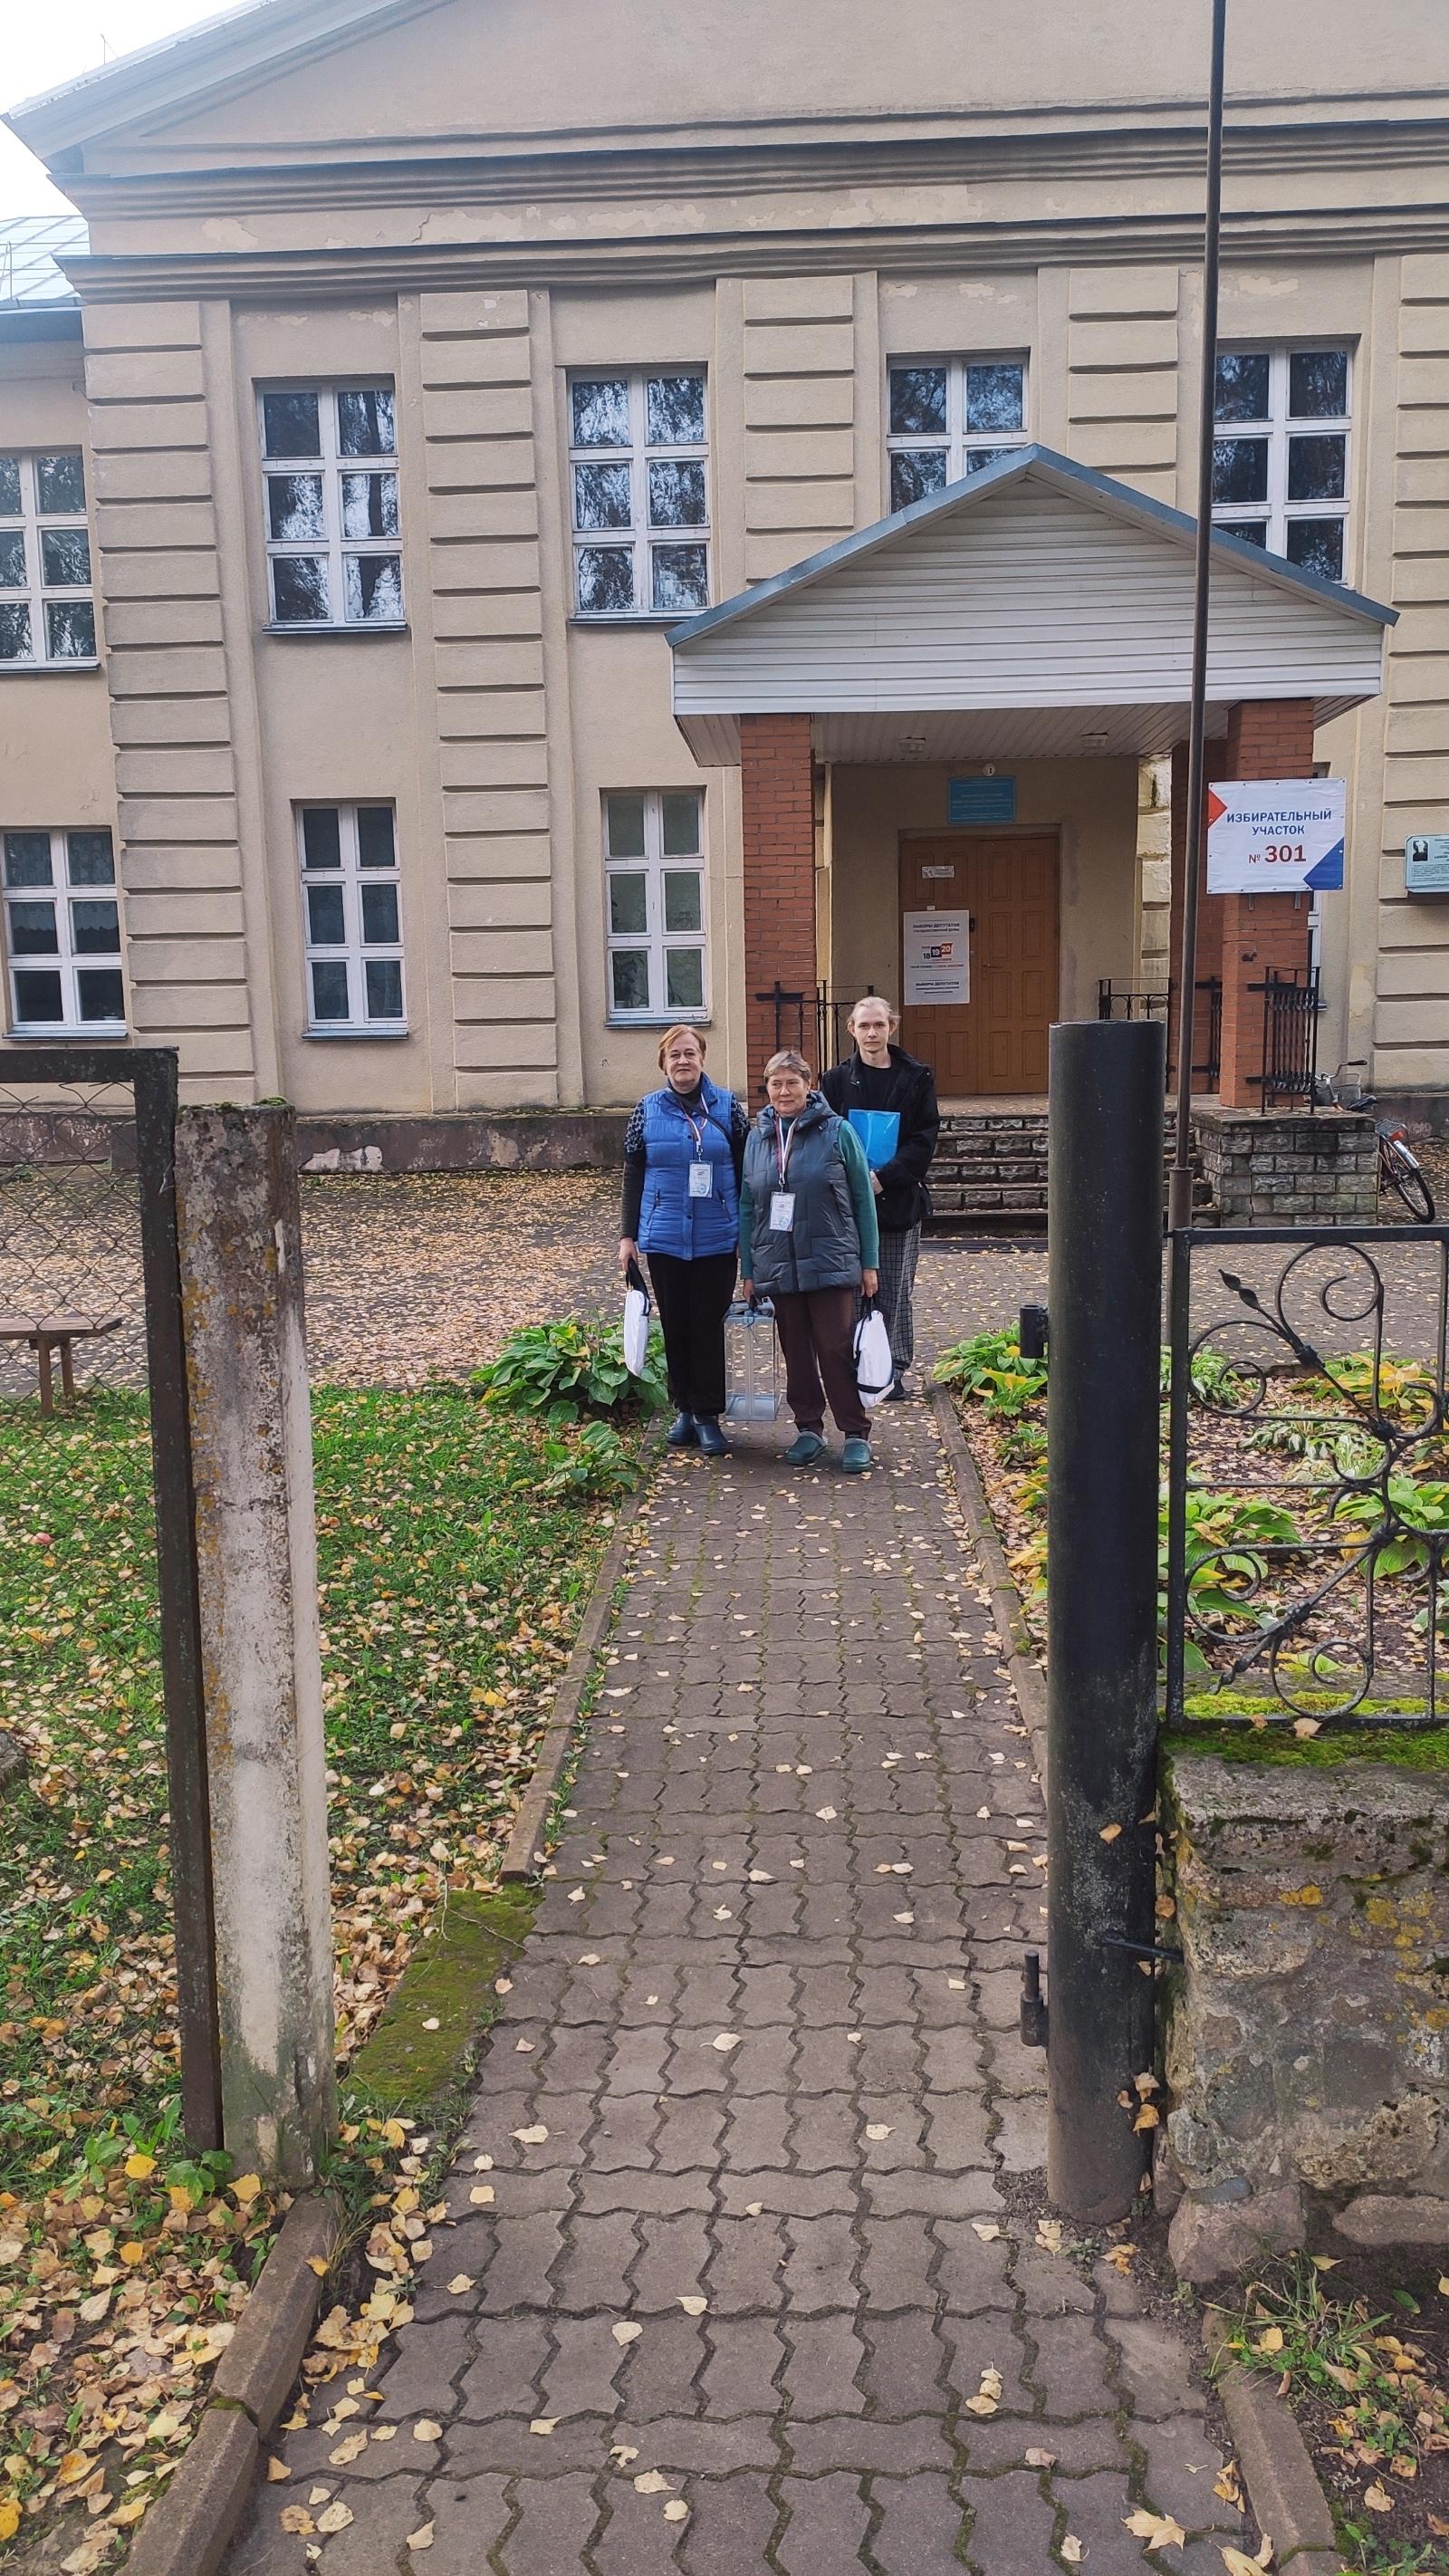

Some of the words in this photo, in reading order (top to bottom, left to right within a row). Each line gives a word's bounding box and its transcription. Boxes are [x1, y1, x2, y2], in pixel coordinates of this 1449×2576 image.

[1226, 808, 1331, 822] ИЗБИРАТЕЛЬНЫЙ
[1252, 825, 1305, 835] УЧАСТОК
[1249, 854, 1261, 863] №
[1264, 844, 1307, 863] 301
